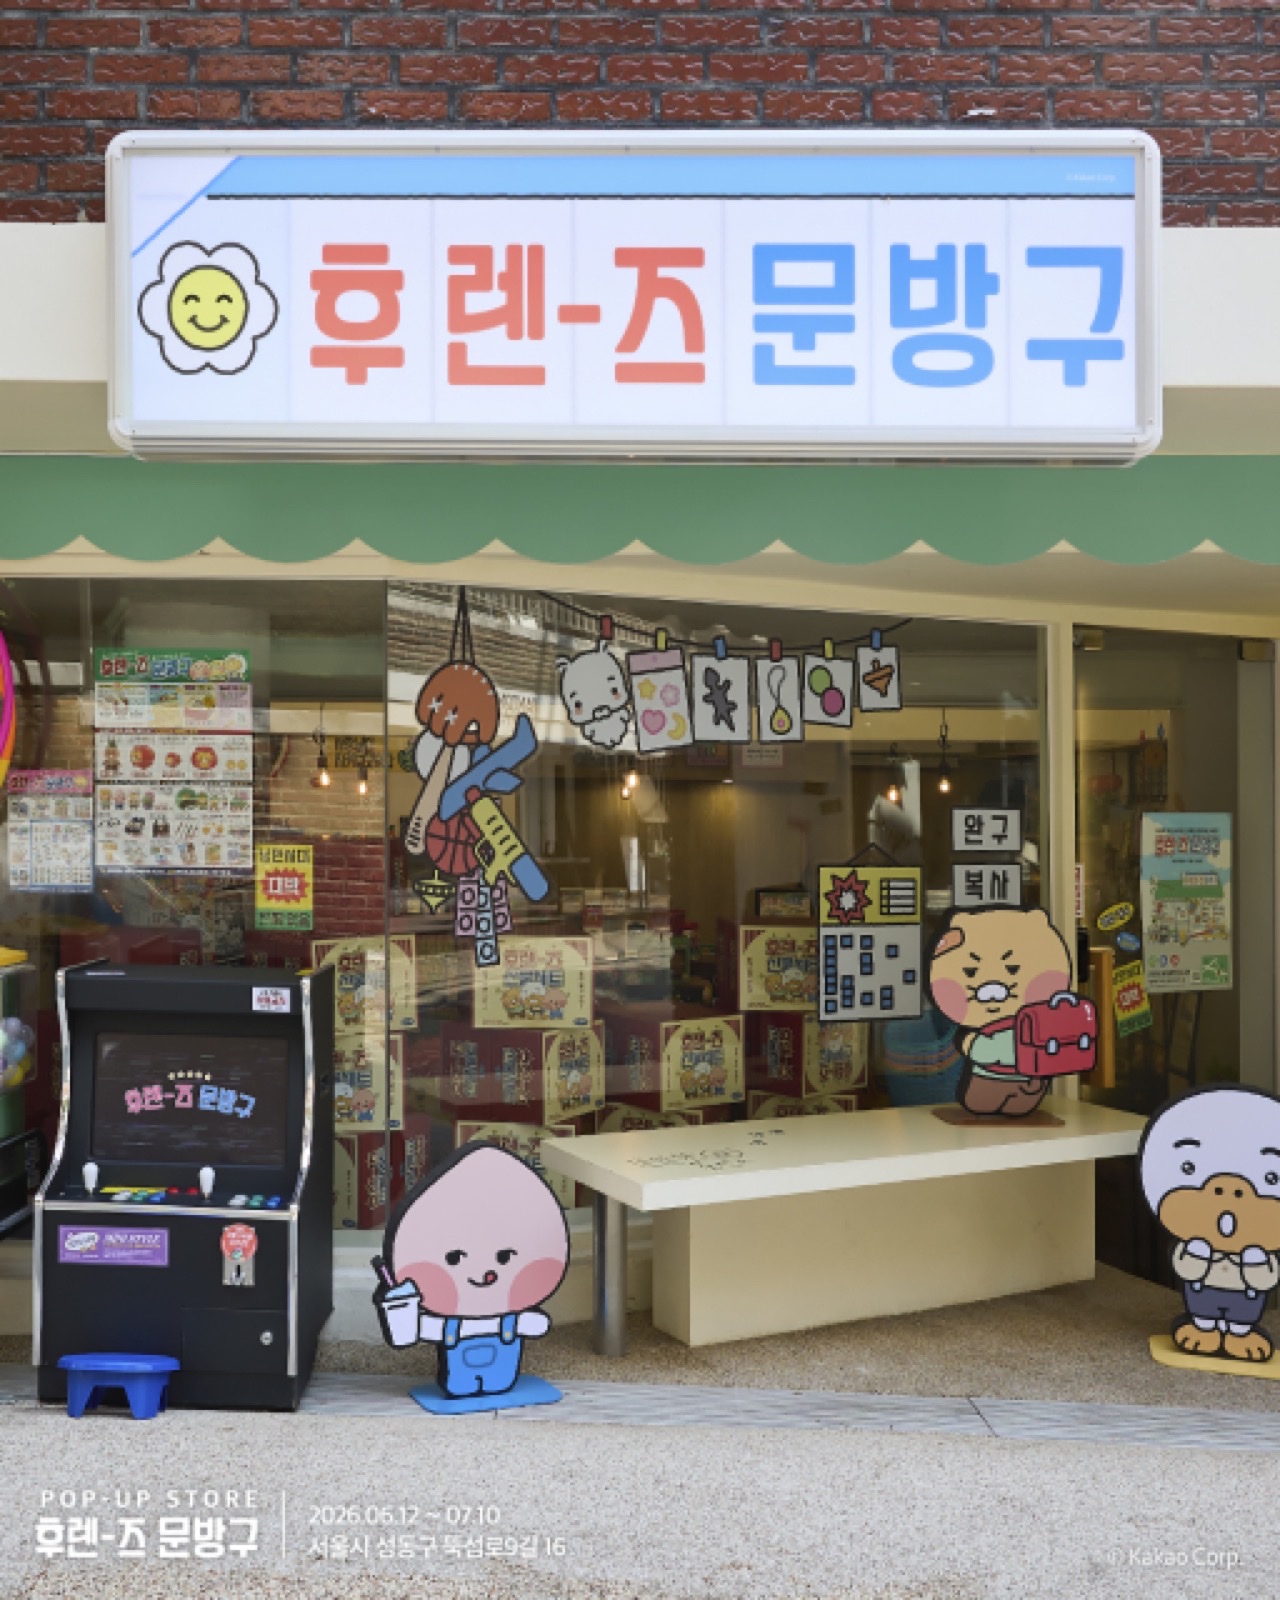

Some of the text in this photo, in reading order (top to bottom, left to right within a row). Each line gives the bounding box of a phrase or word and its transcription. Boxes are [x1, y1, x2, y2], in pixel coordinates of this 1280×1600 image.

[310, 242, 1125, 388] 후렌-즈 문방구
[964, 814, 1009, 846] 완구
[964, 870, 1010, 901] 복사
